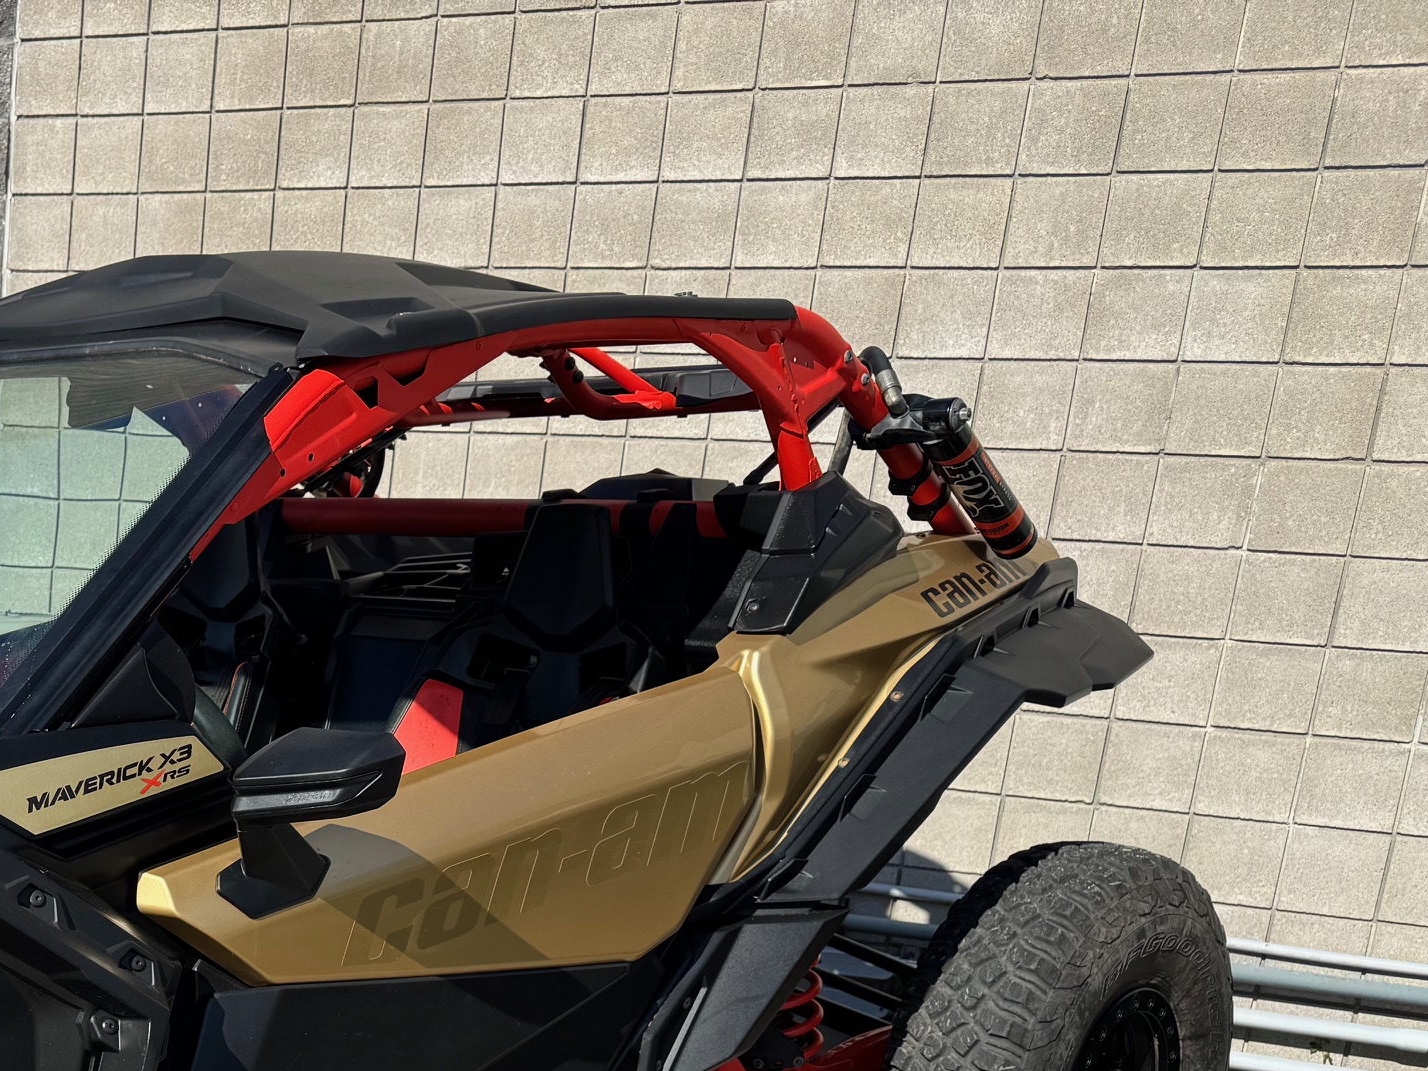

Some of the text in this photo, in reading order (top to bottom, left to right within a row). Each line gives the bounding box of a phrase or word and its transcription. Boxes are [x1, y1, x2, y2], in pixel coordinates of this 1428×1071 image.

[27, 743, 193, 814] MAVERICK X3
[340, 760, 751, 967] can-am
